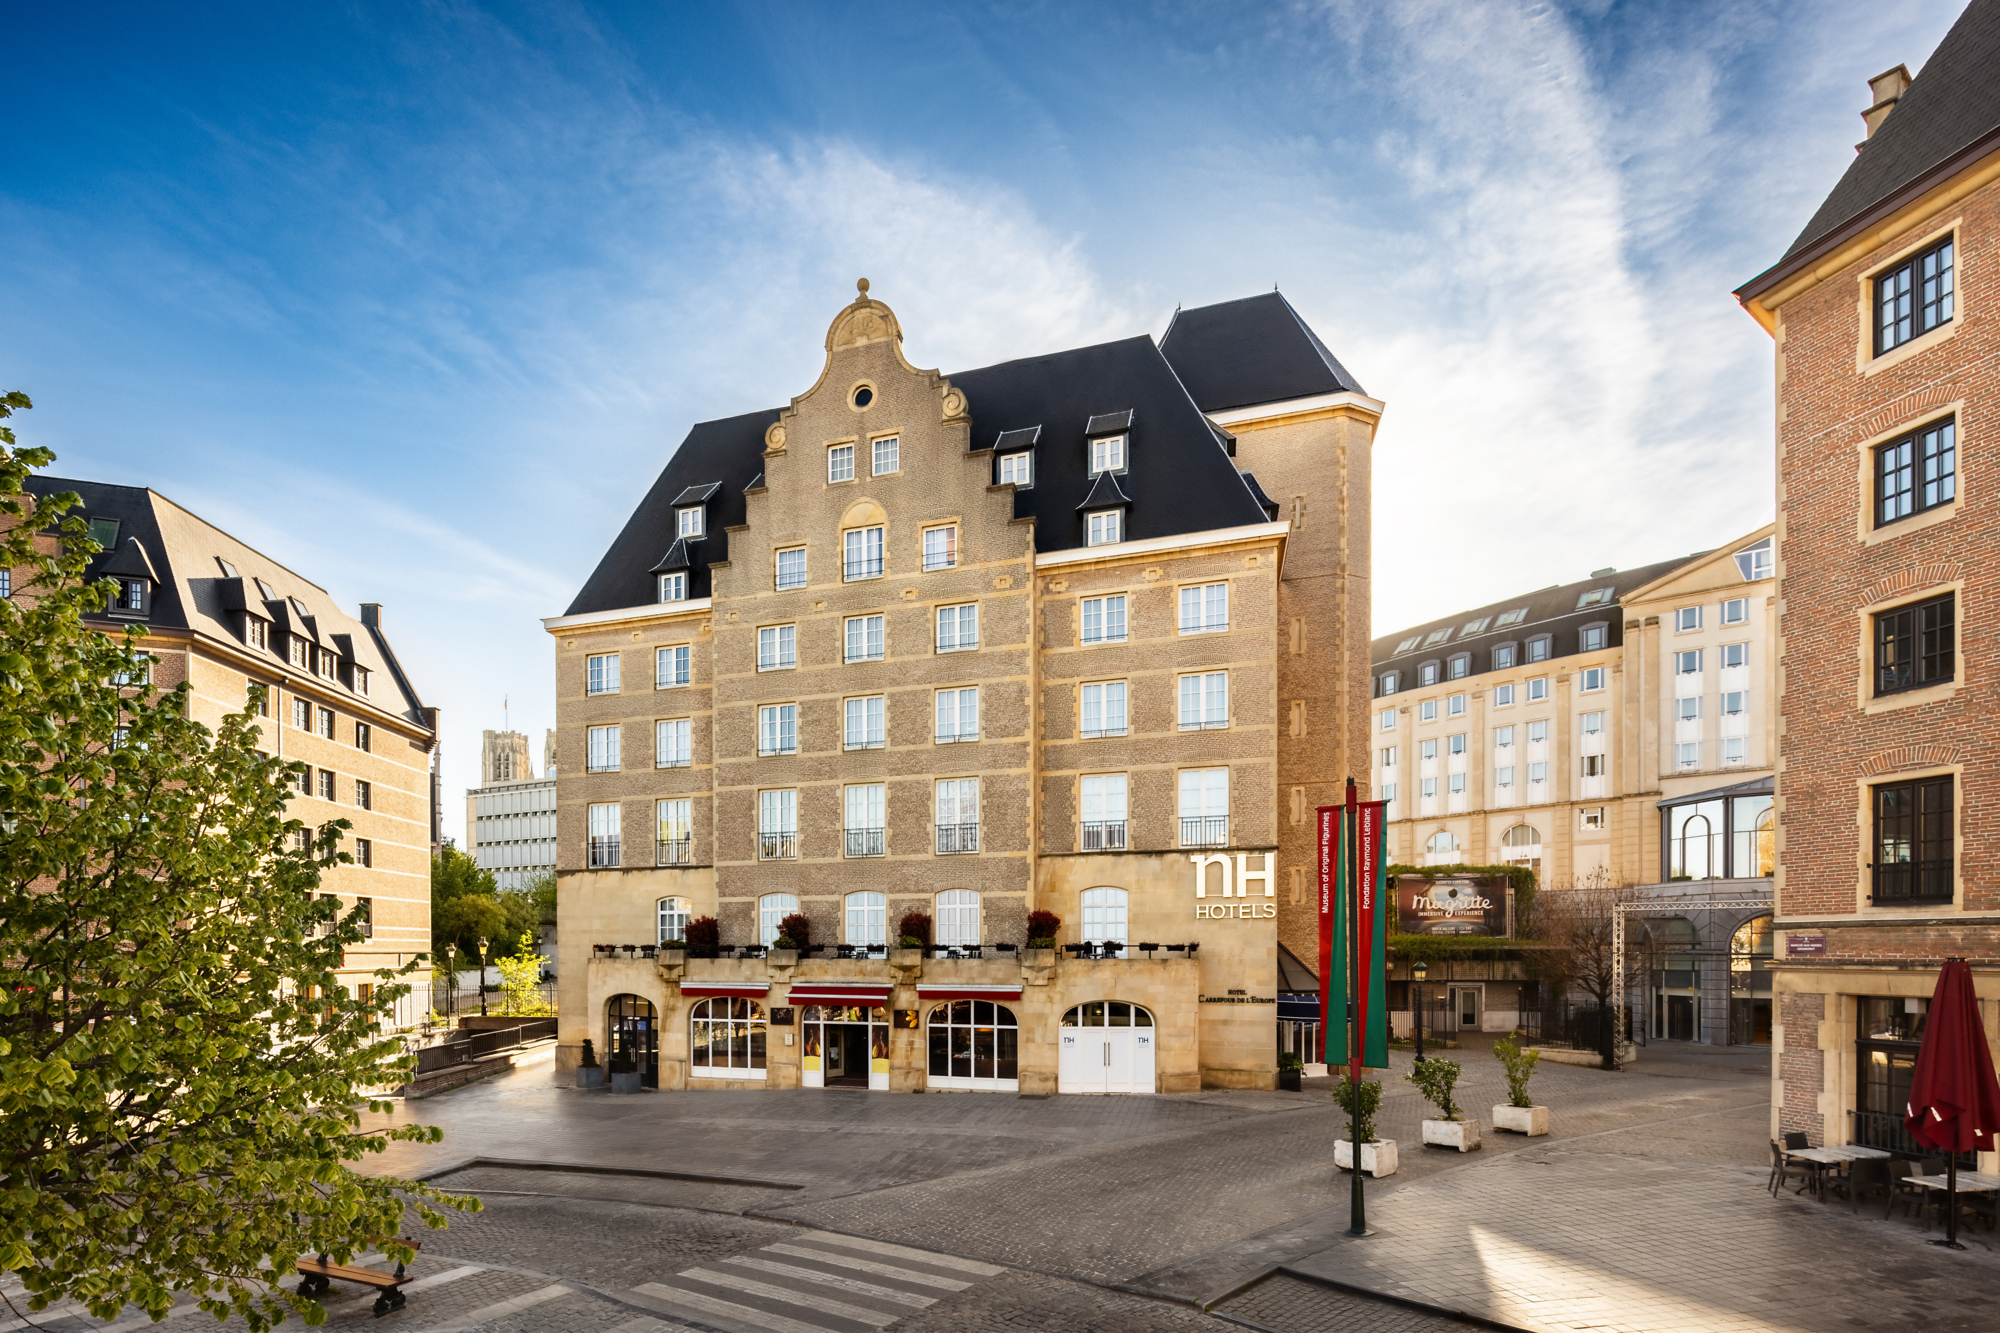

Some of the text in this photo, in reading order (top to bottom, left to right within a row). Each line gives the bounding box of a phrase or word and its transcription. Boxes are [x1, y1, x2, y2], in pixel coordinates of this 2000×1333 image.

[1321, 811, 1331, 914] Museum of Original Figurines
[1362, 807, 1372, 909] Fondation Raymond Leblanc
[1196, 903, 1276, 919] HOTELS
[1411, 894, 1493, 919] Magritte
